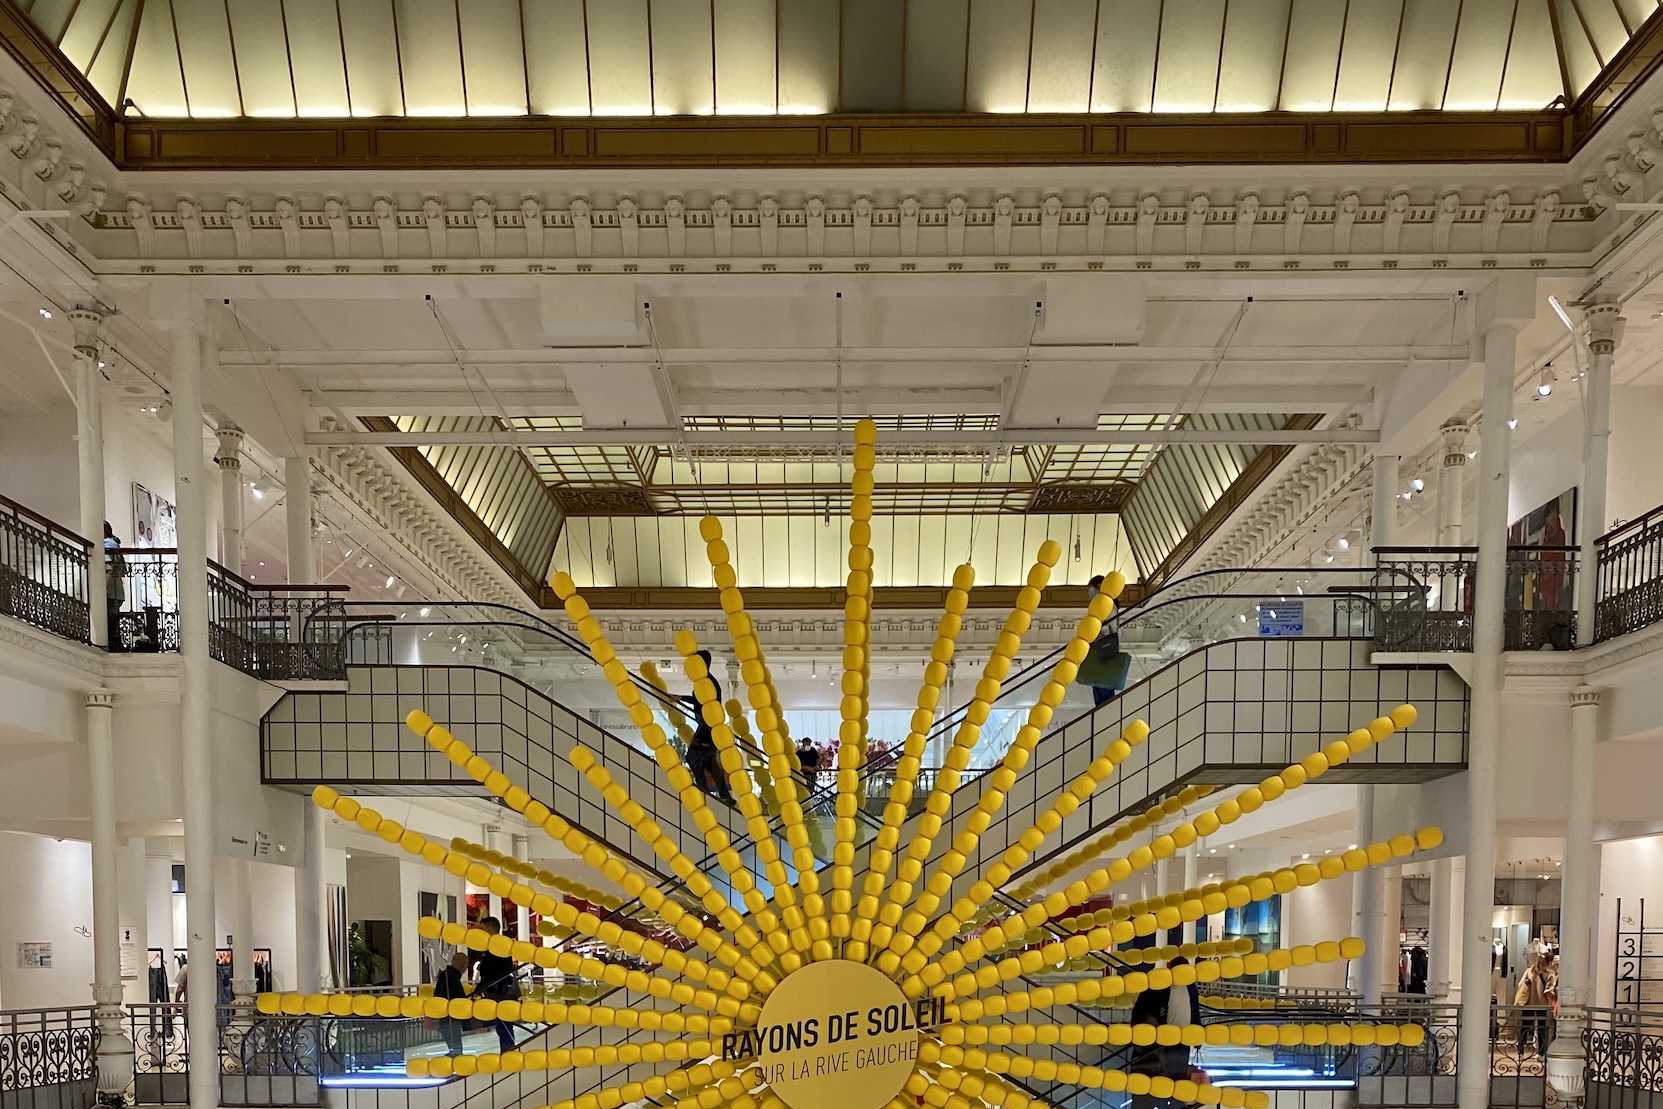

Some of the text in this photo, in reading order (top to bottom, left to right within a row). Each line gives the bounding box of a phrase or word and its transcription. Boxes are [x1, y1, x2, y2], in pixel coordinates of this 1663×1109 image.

[1623, 938, 1636, 956] 3
[1622, 961, 1635, 979] 2
[1623, 984, 1632, 1003] 1
[722, 996, 953, 1062] RAYONS DE SOLEIL
[754, 1040, 918, 1087] SUR LA RIVE GAUCHE
